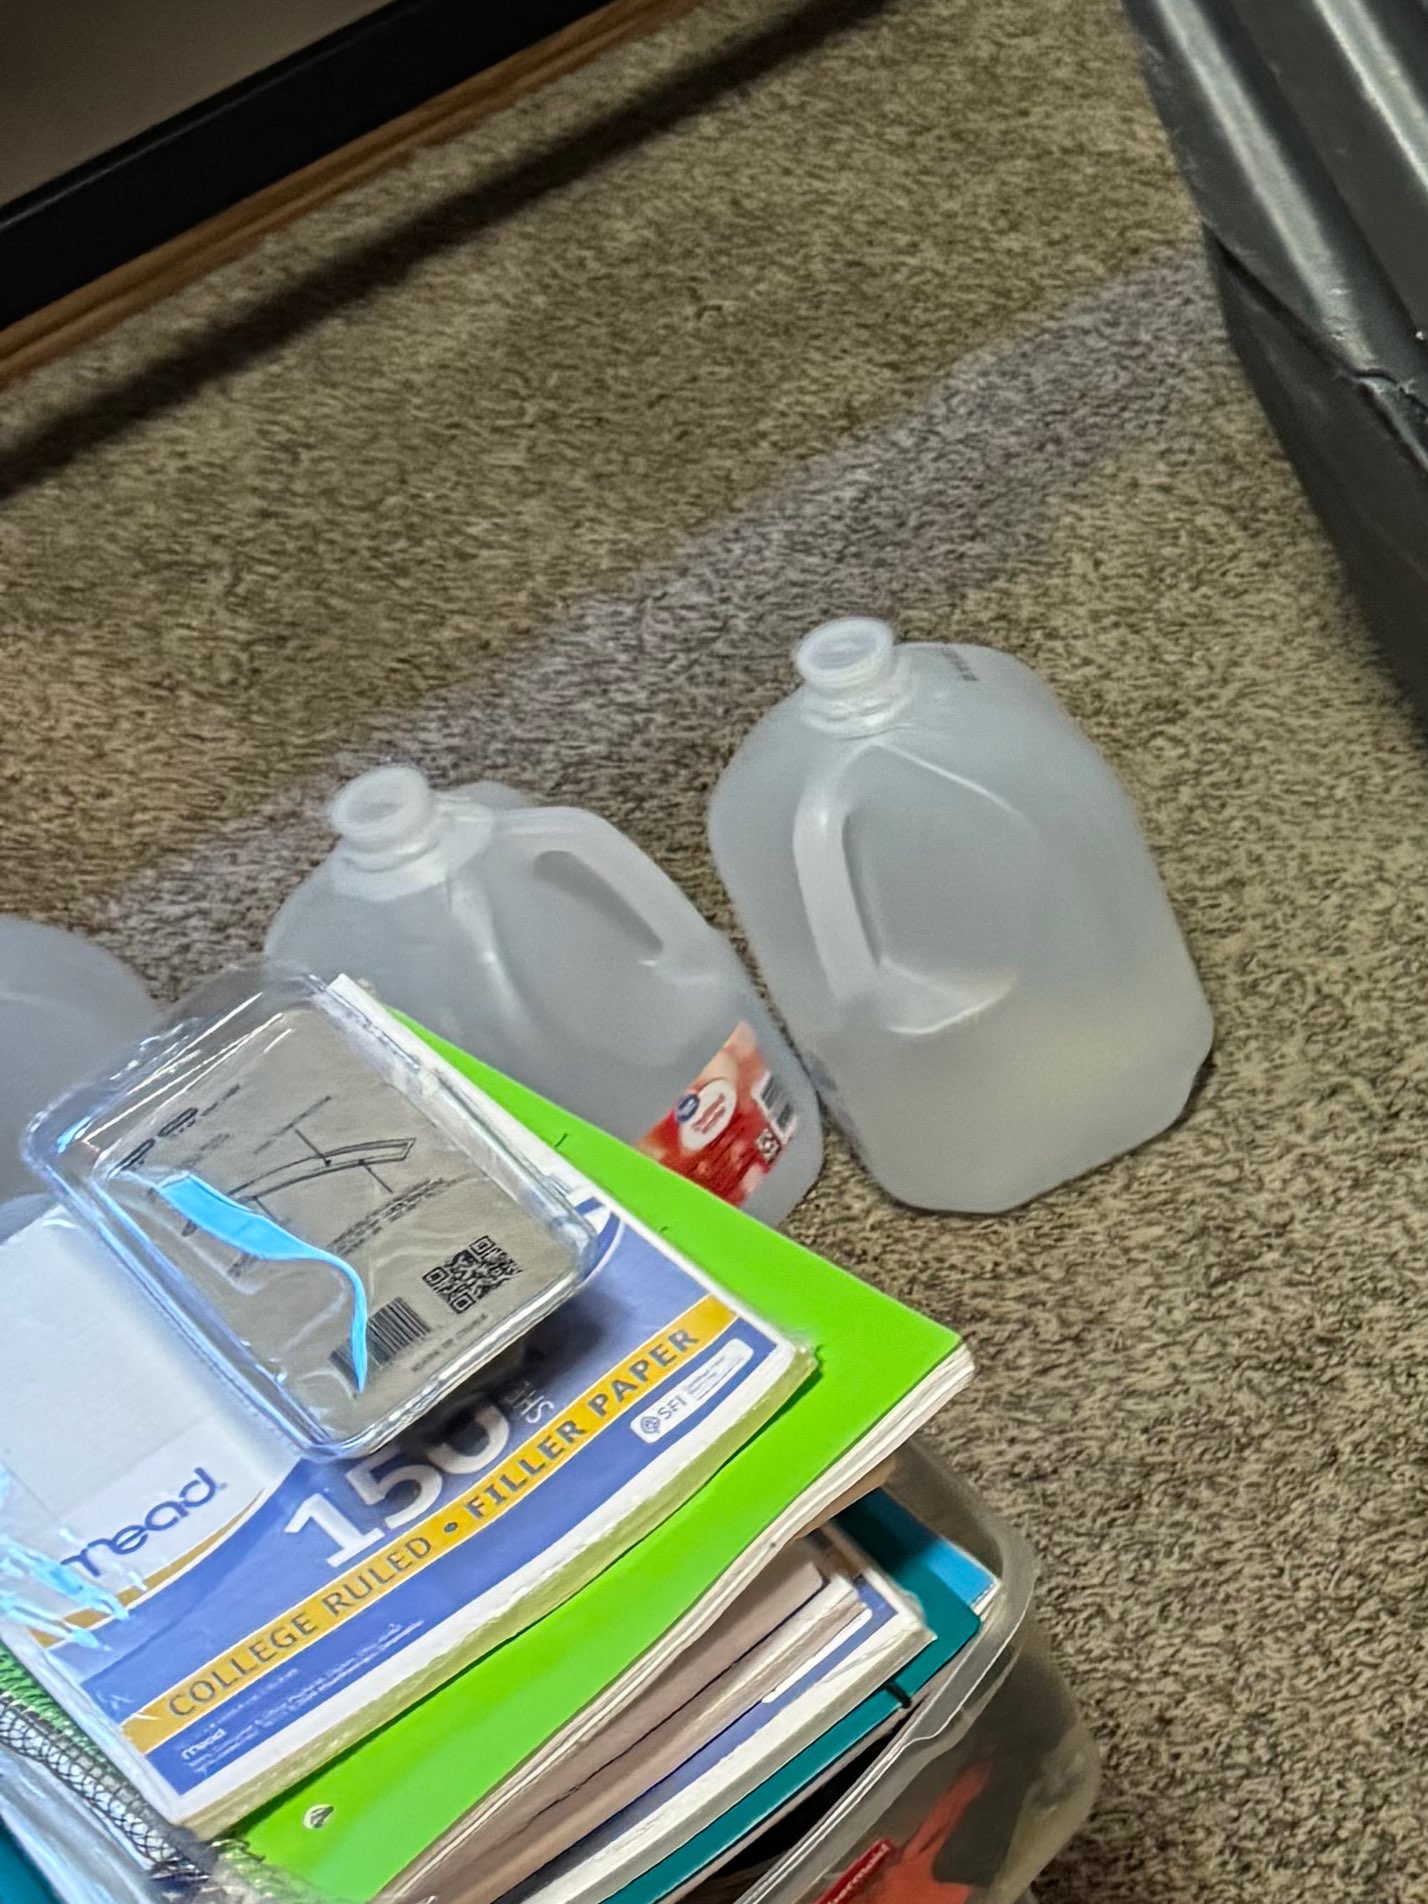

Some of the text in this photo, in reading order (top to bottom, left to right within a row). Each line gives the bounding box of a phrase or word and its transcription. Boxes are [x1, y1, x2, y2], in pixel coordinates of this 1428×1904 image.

[657, 1394, 687, 1420] SFI
[61, 1467, 217, 1577] mead
[168, 1612, 318, 1717] COLLEGE
[322, 1536, 432, 1617] RULED
[464, 1420, 587, 1520] FILLER
[587, 1328, 699, 1418] PAPER
